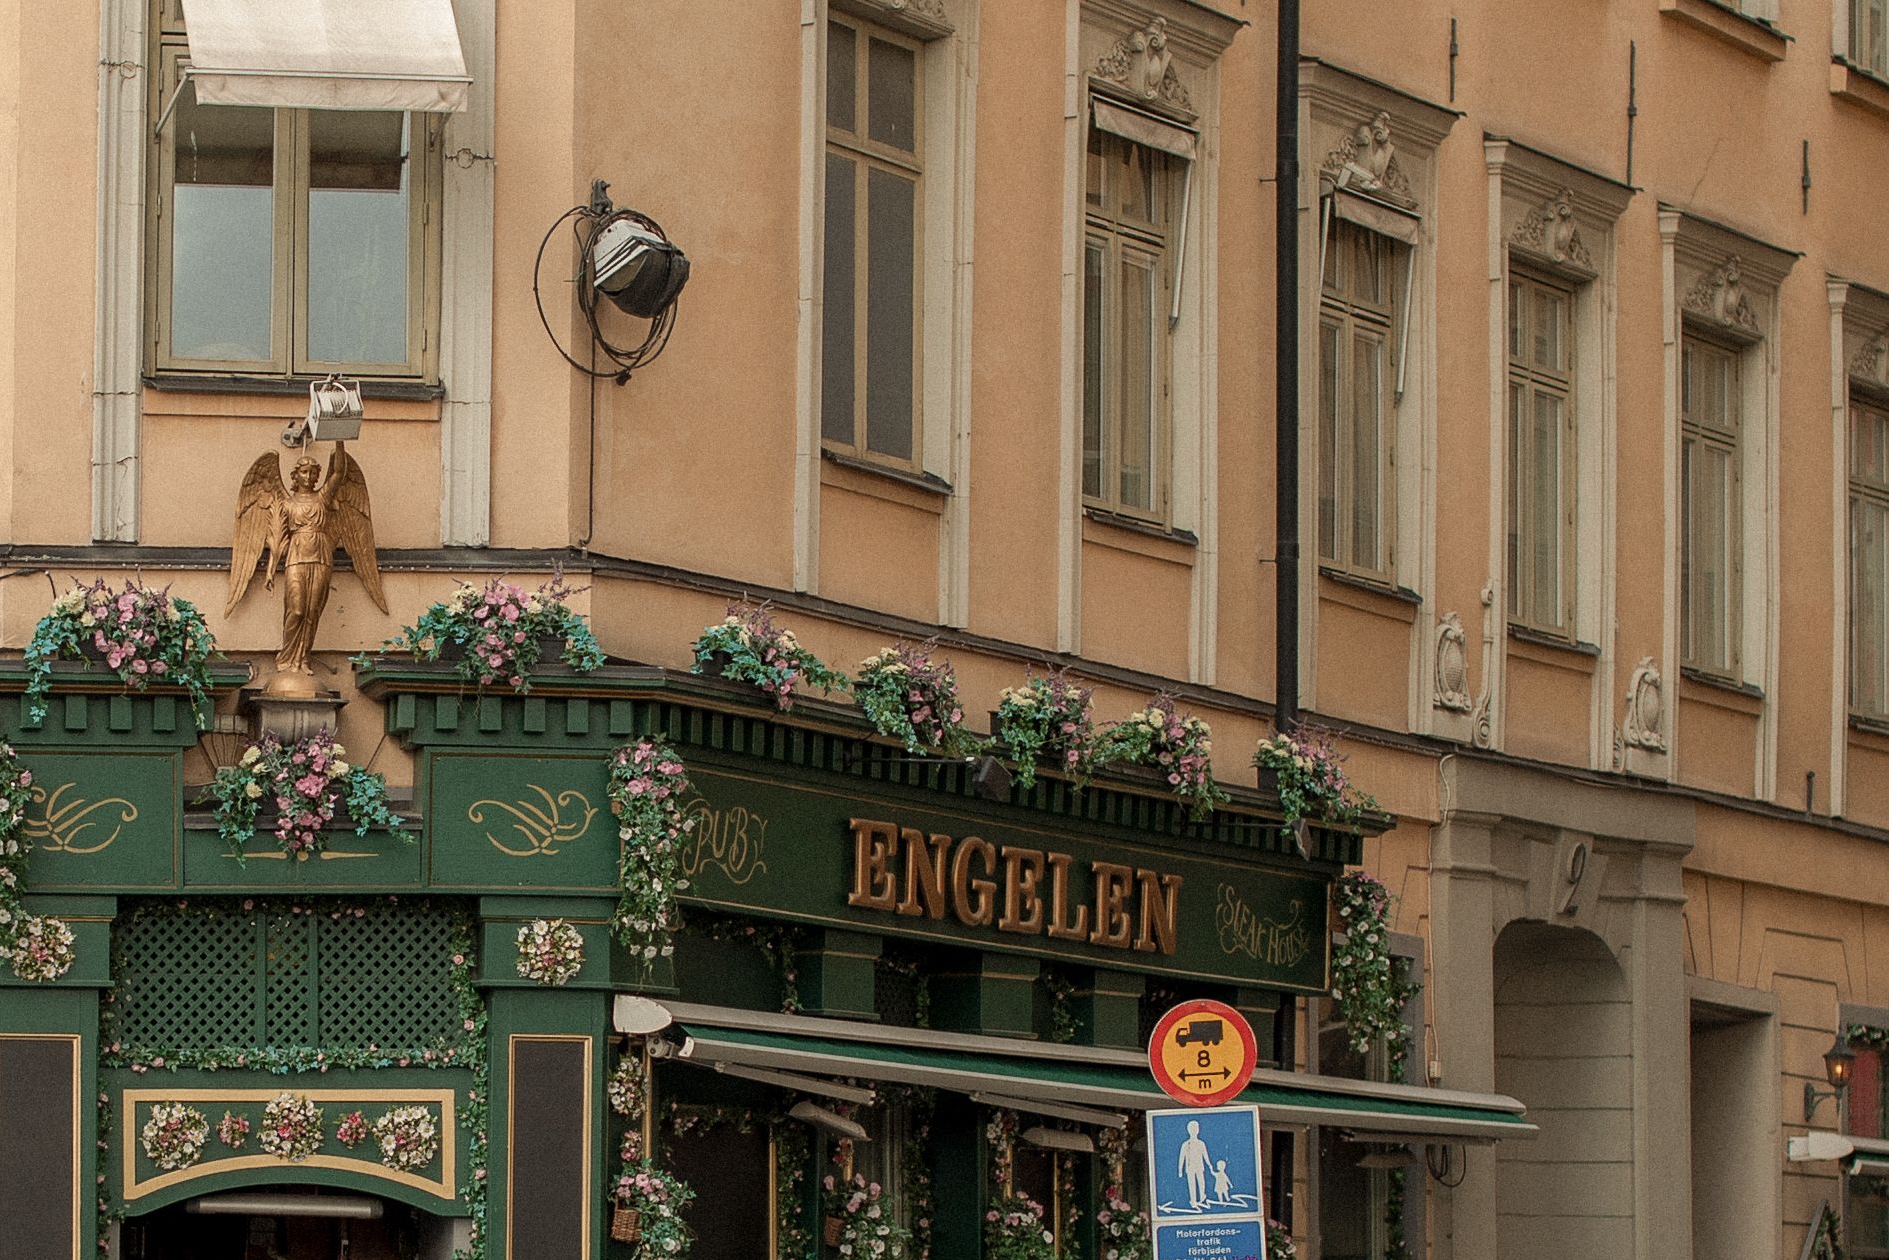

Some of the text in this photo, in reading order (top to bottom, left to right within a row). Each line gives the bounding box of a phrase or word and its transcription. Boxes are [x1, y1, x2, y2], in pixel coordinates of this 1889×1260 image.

[681, 806, 748, 876] PUB
[848, 818, 1183, 956] ENGELEN
[1197, 1050, 1211, 1068] 8
[1198, 1078, 1212, 1089] m
[1196, 1237, 1221, 1246] trafik
[1188, 1246, 1231, 1256] förbjuden
